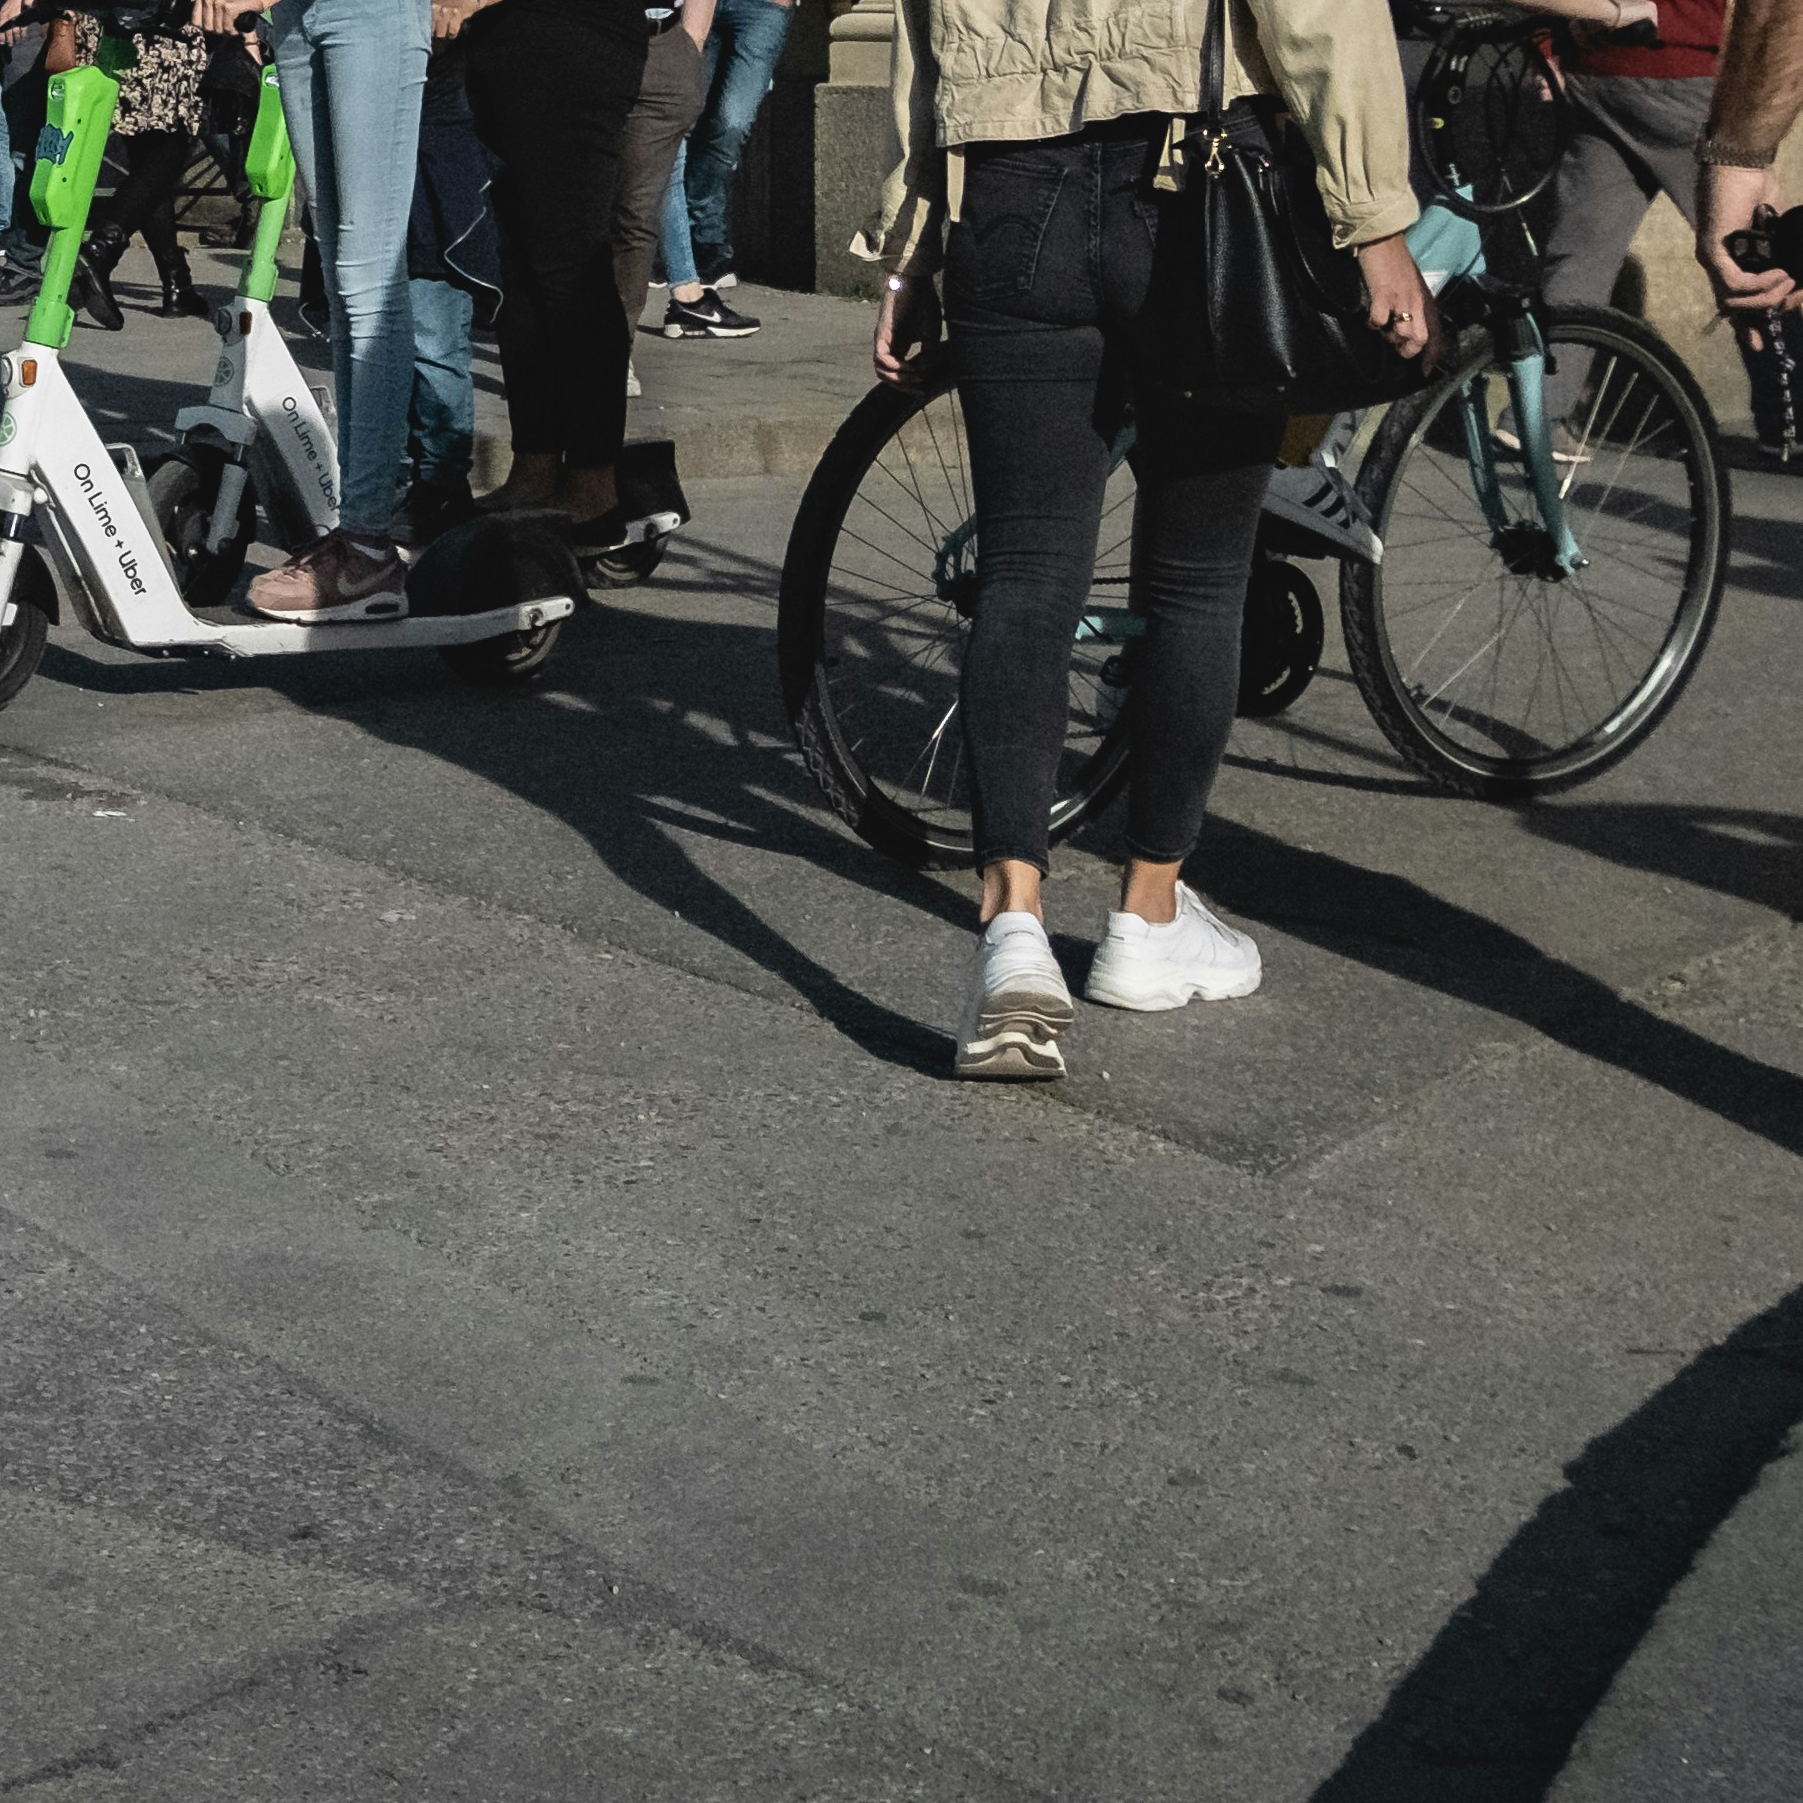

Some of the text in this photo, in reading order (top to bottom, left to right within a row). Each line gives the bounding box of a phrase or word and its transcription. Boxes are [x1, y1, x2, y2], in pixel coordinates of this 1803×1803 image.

[283, 396, 301, 424] On
[293, 420, 318, 463] Lime
[73, 463, 148, 597] On Lime + Uber
